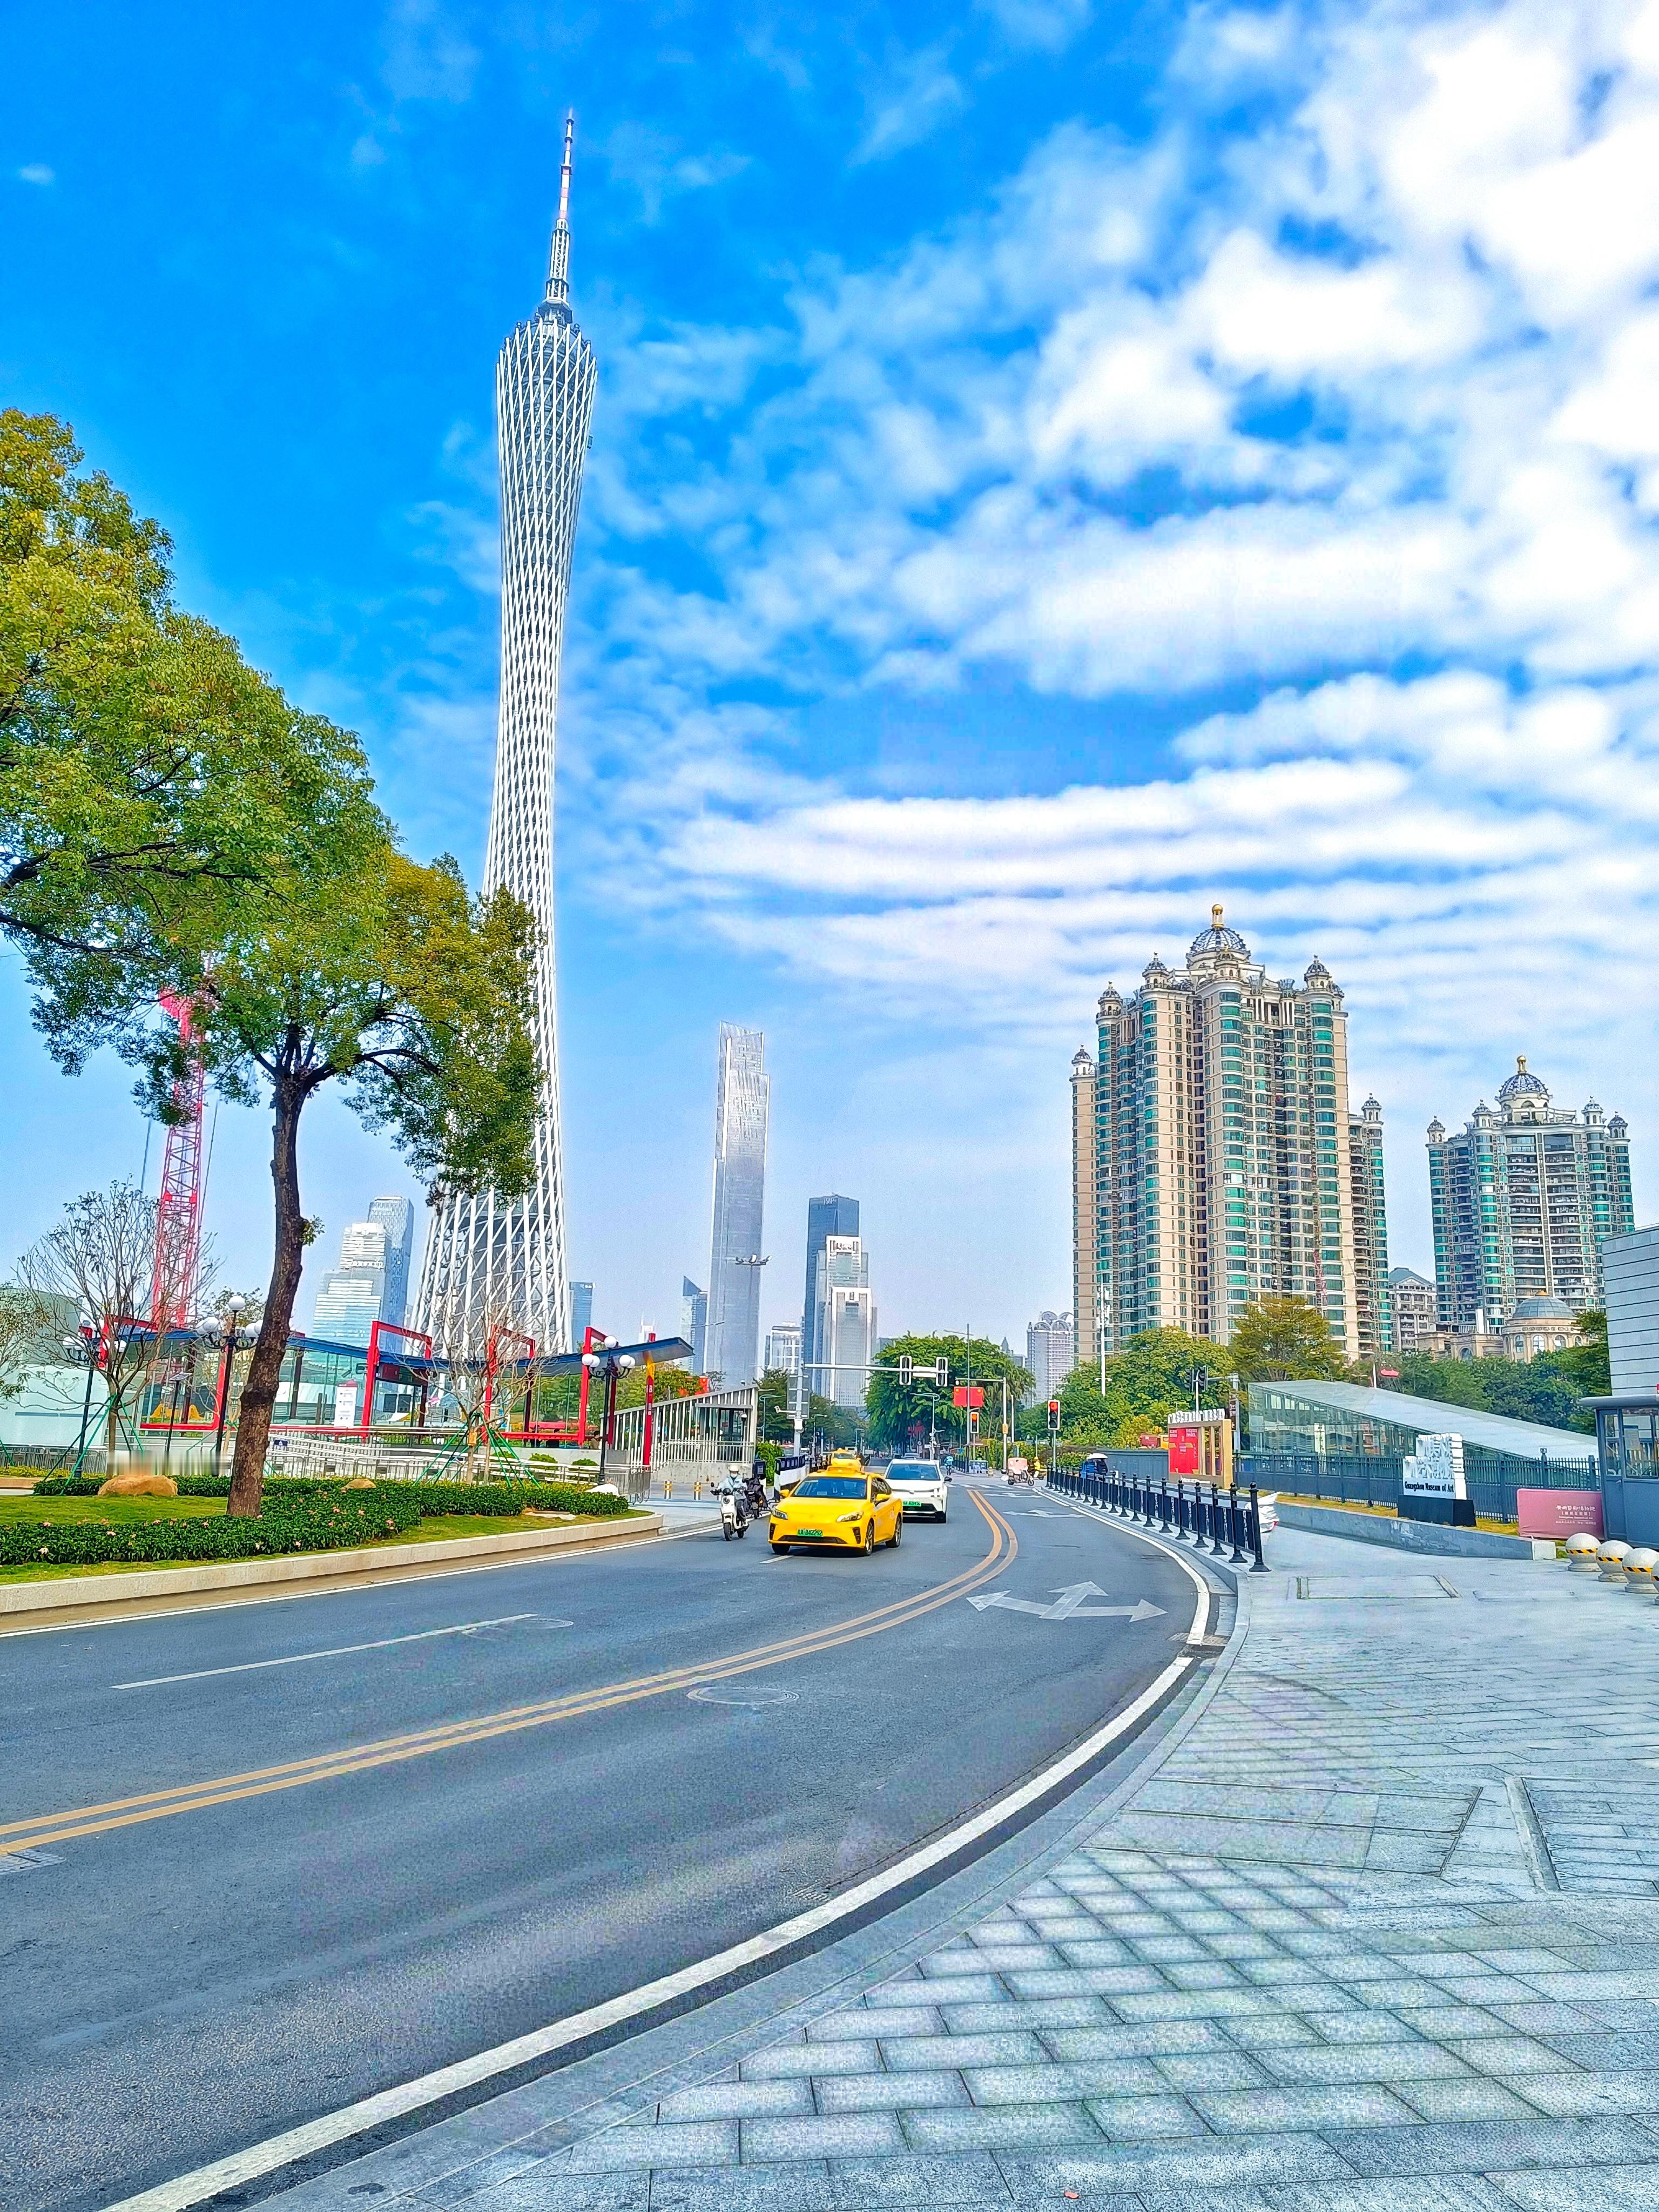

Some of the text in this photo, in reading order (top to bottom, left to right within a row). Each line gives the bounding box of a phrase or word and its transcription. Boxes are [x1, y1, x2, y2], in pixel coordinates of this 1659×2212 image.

[1405, 1481, 1424, 1492] Guangzhou
[1425, 1483, 1441, 1491] Museum
[1442, 1483, 1446, 1492] of
